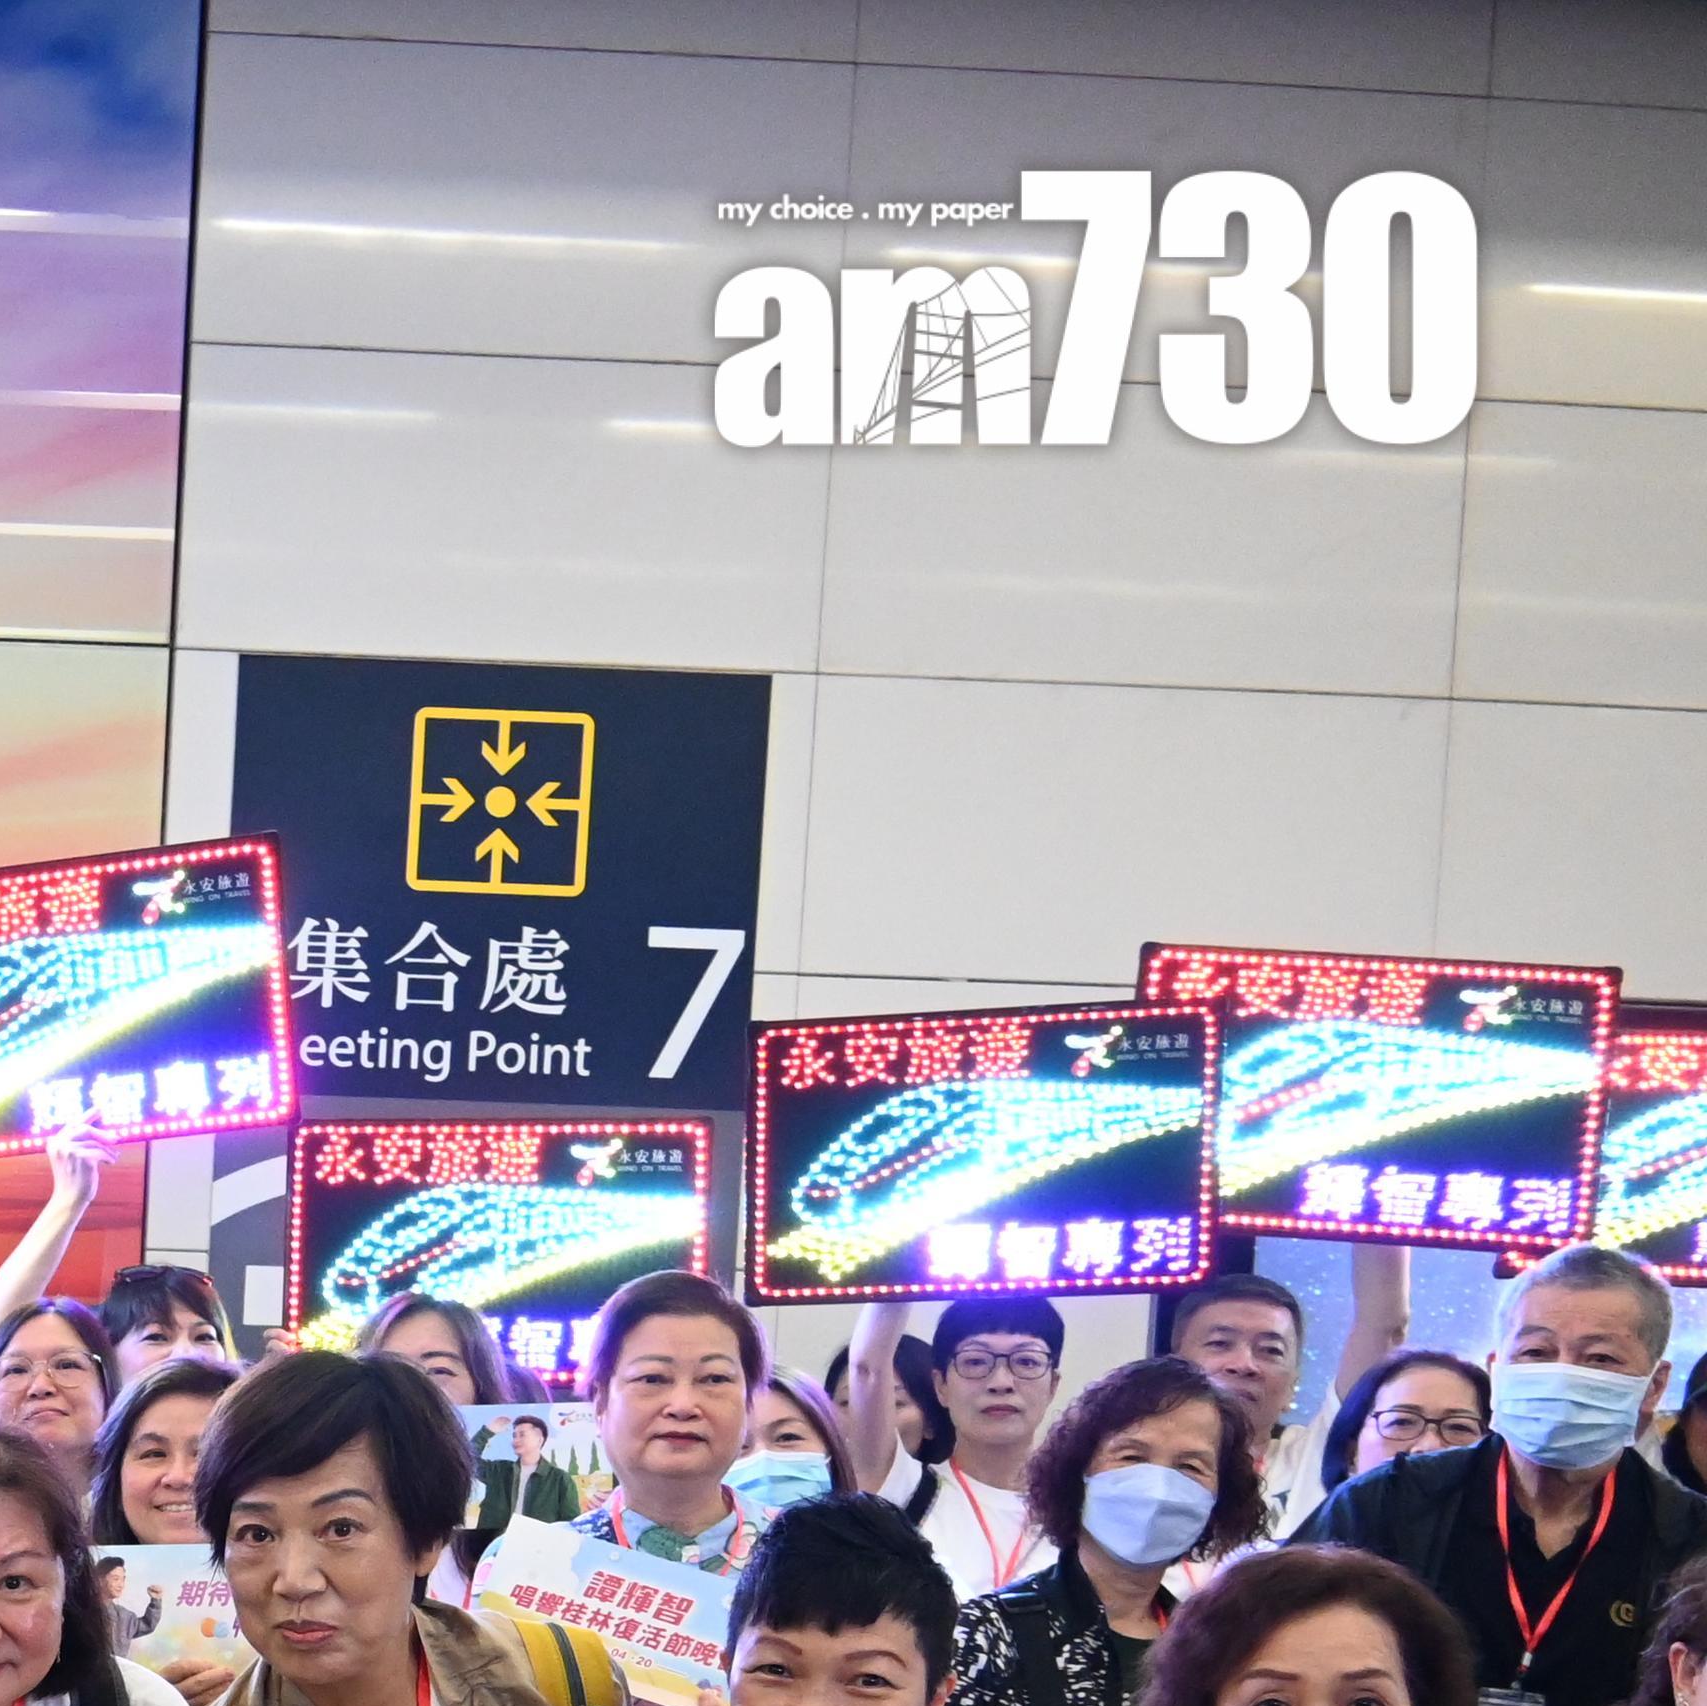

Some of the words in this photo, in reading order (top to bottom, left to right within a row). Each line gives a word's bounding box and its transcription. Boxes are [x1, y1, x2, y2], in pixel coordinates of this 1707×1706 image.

[184, 871, 251, 895] 永安旅遊
[286, 916, 570, 1016] 集合處
[647, 925, 746, 1080] 7
[298, 1026, 452, 1083] eeting
[468, 1030, 592, 1078] Point
[780, 1021, 1033, 1091] 永安旅遊
[315, 1132, 542, 1185] 永安旅遊
[617, 1148, 683, 1165] 永安旅遊
[583, 1570, 695, 1627] 譚輝智
